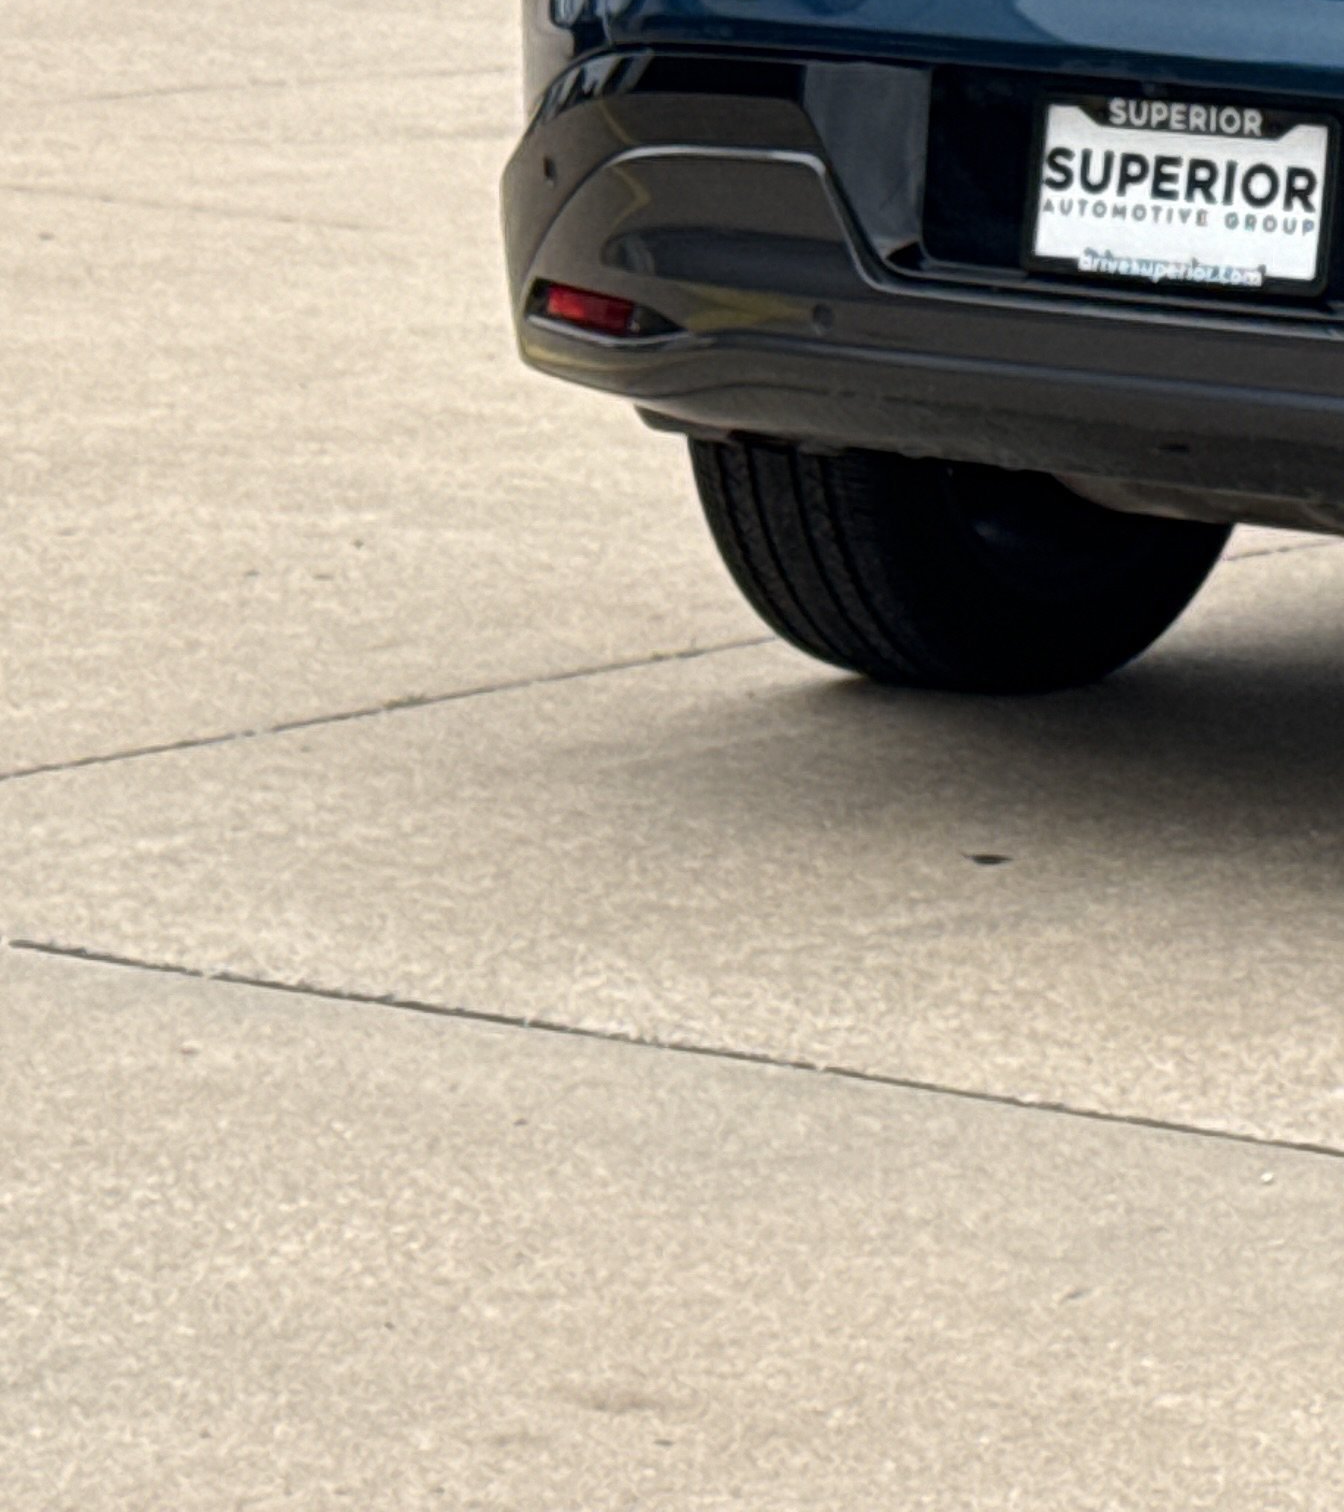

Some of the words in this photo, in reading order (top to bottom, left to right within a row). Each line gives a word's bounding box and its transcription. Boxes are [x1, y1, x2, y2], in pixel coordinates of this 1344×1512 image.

[1108, 96, 1263, 136] SUPERIOR
[1042, 146, 1318, 214] SUPERIOR
[1042, 199, 1209, 228] AUTOMOTIVE
[1223, 211, 1316, 237] GROUP
